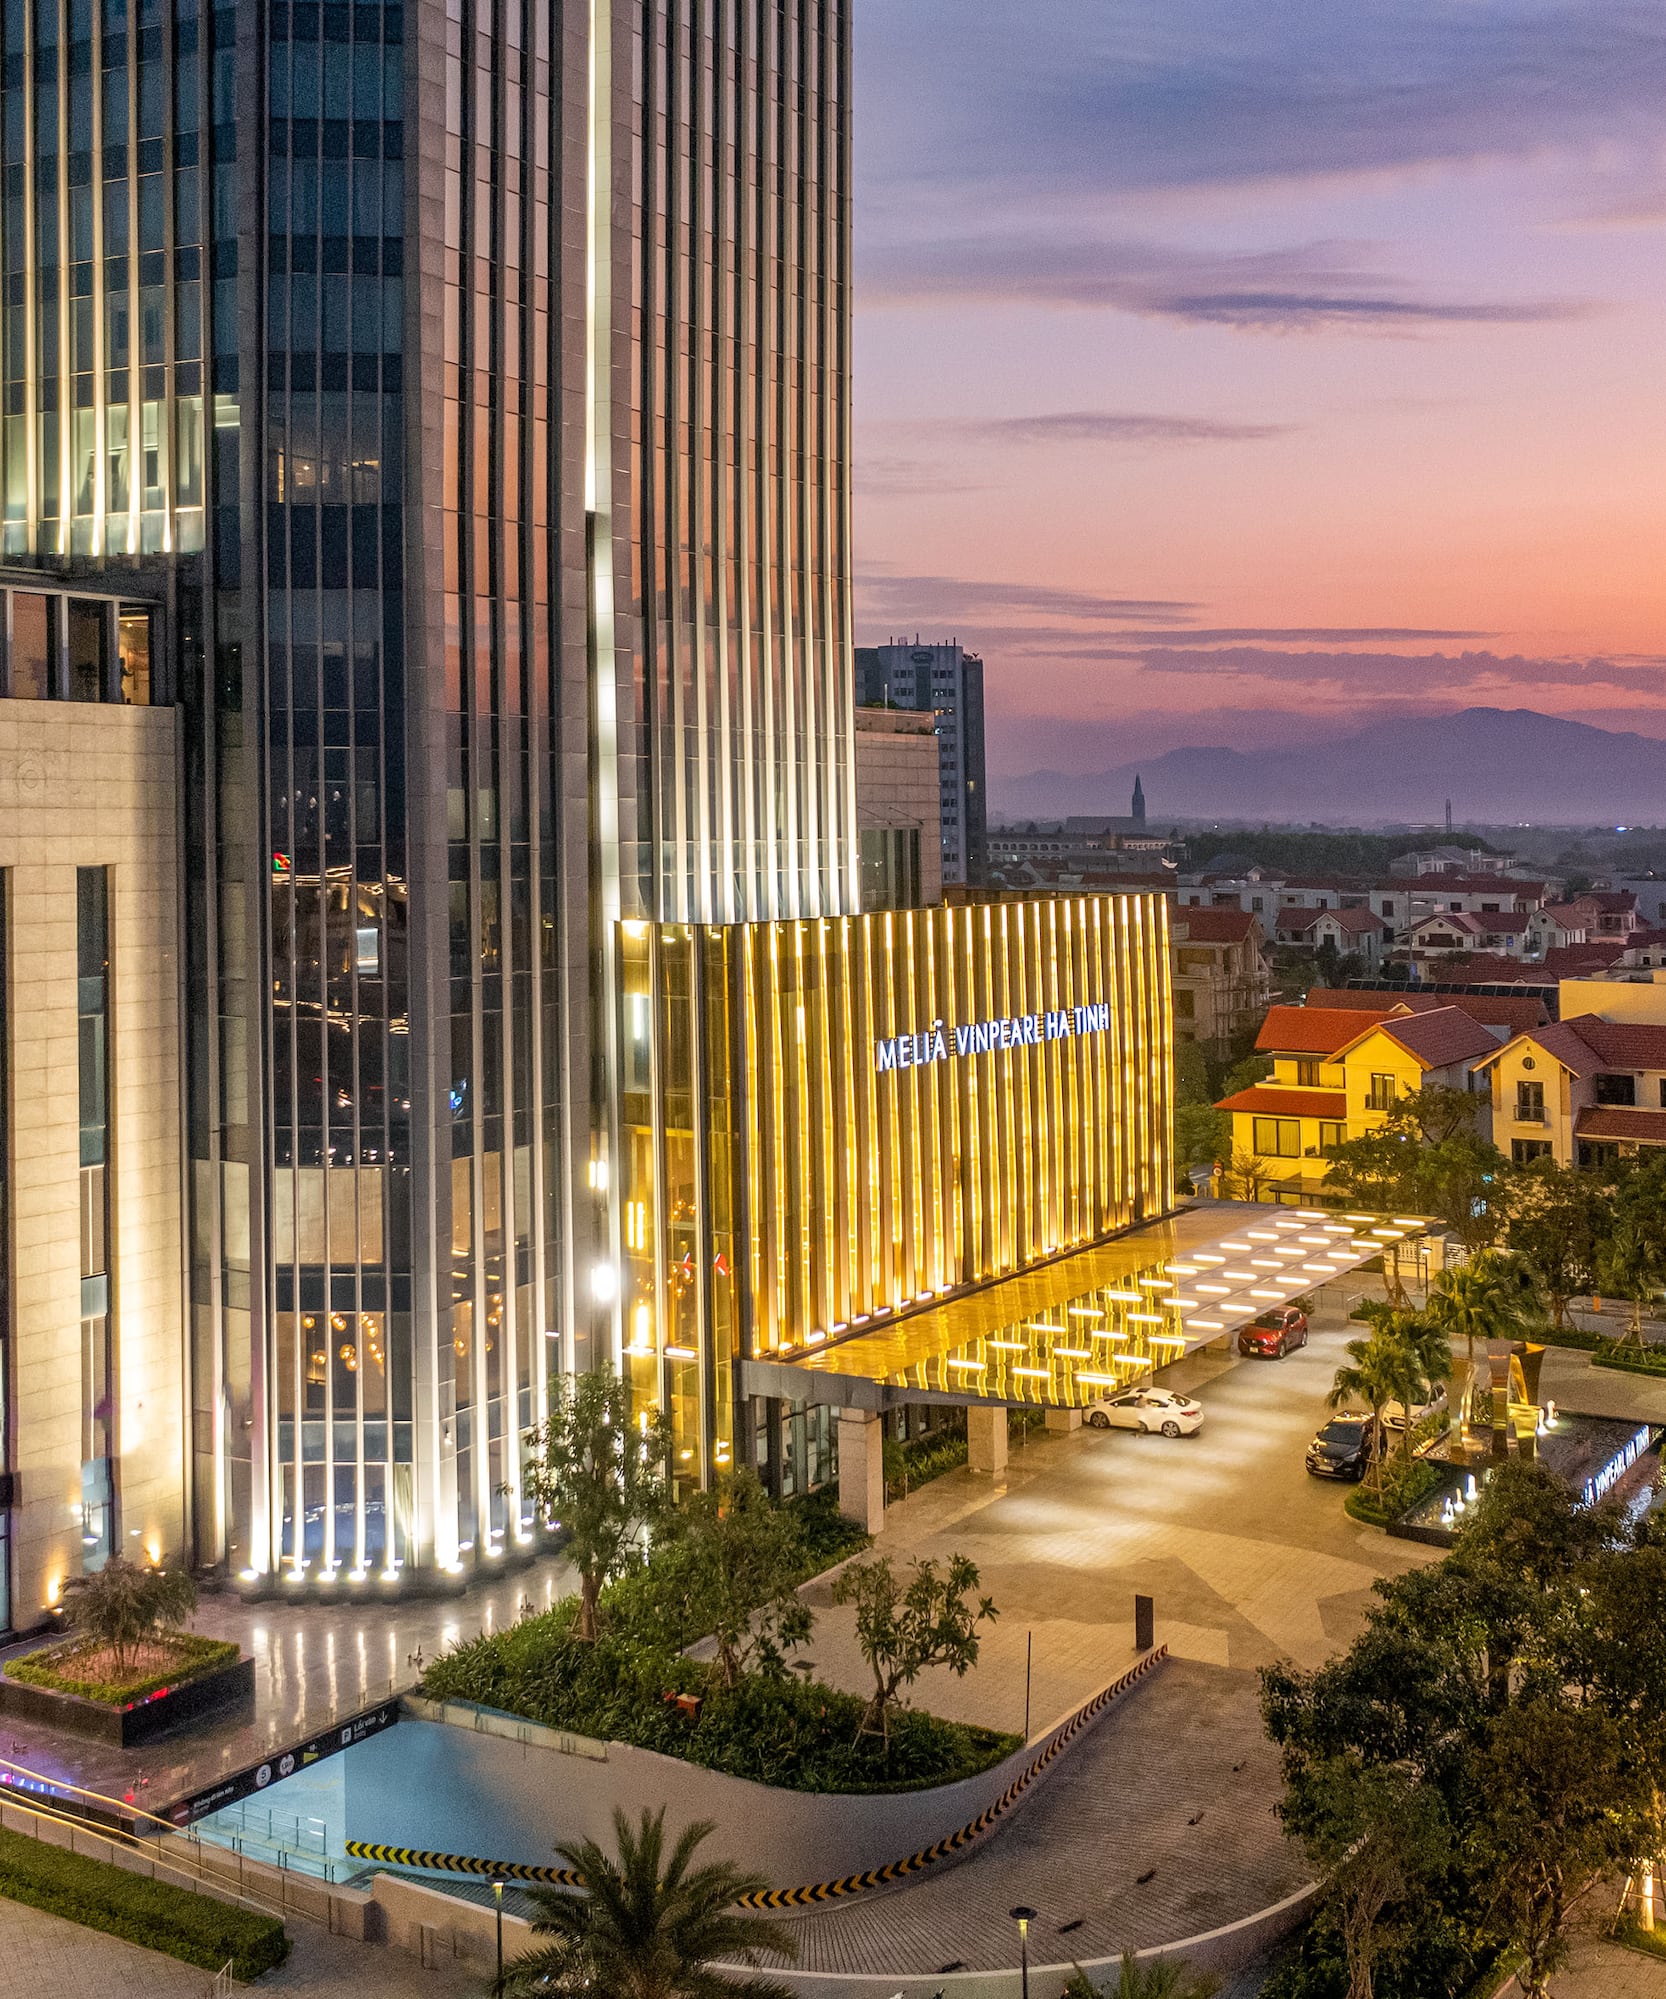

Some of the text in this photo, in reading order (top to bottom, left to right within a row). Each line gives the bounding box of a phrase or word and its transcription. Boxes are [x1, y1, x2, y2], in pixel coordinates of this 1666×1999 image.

[955, 1014, 1042, 1056] VINPEARL
[1046, 1010, 1070, 1041] HA
[1074, 1003, 1110, 1035] TINH
[1594, 1450, 1627, 1503] VINPEARL
